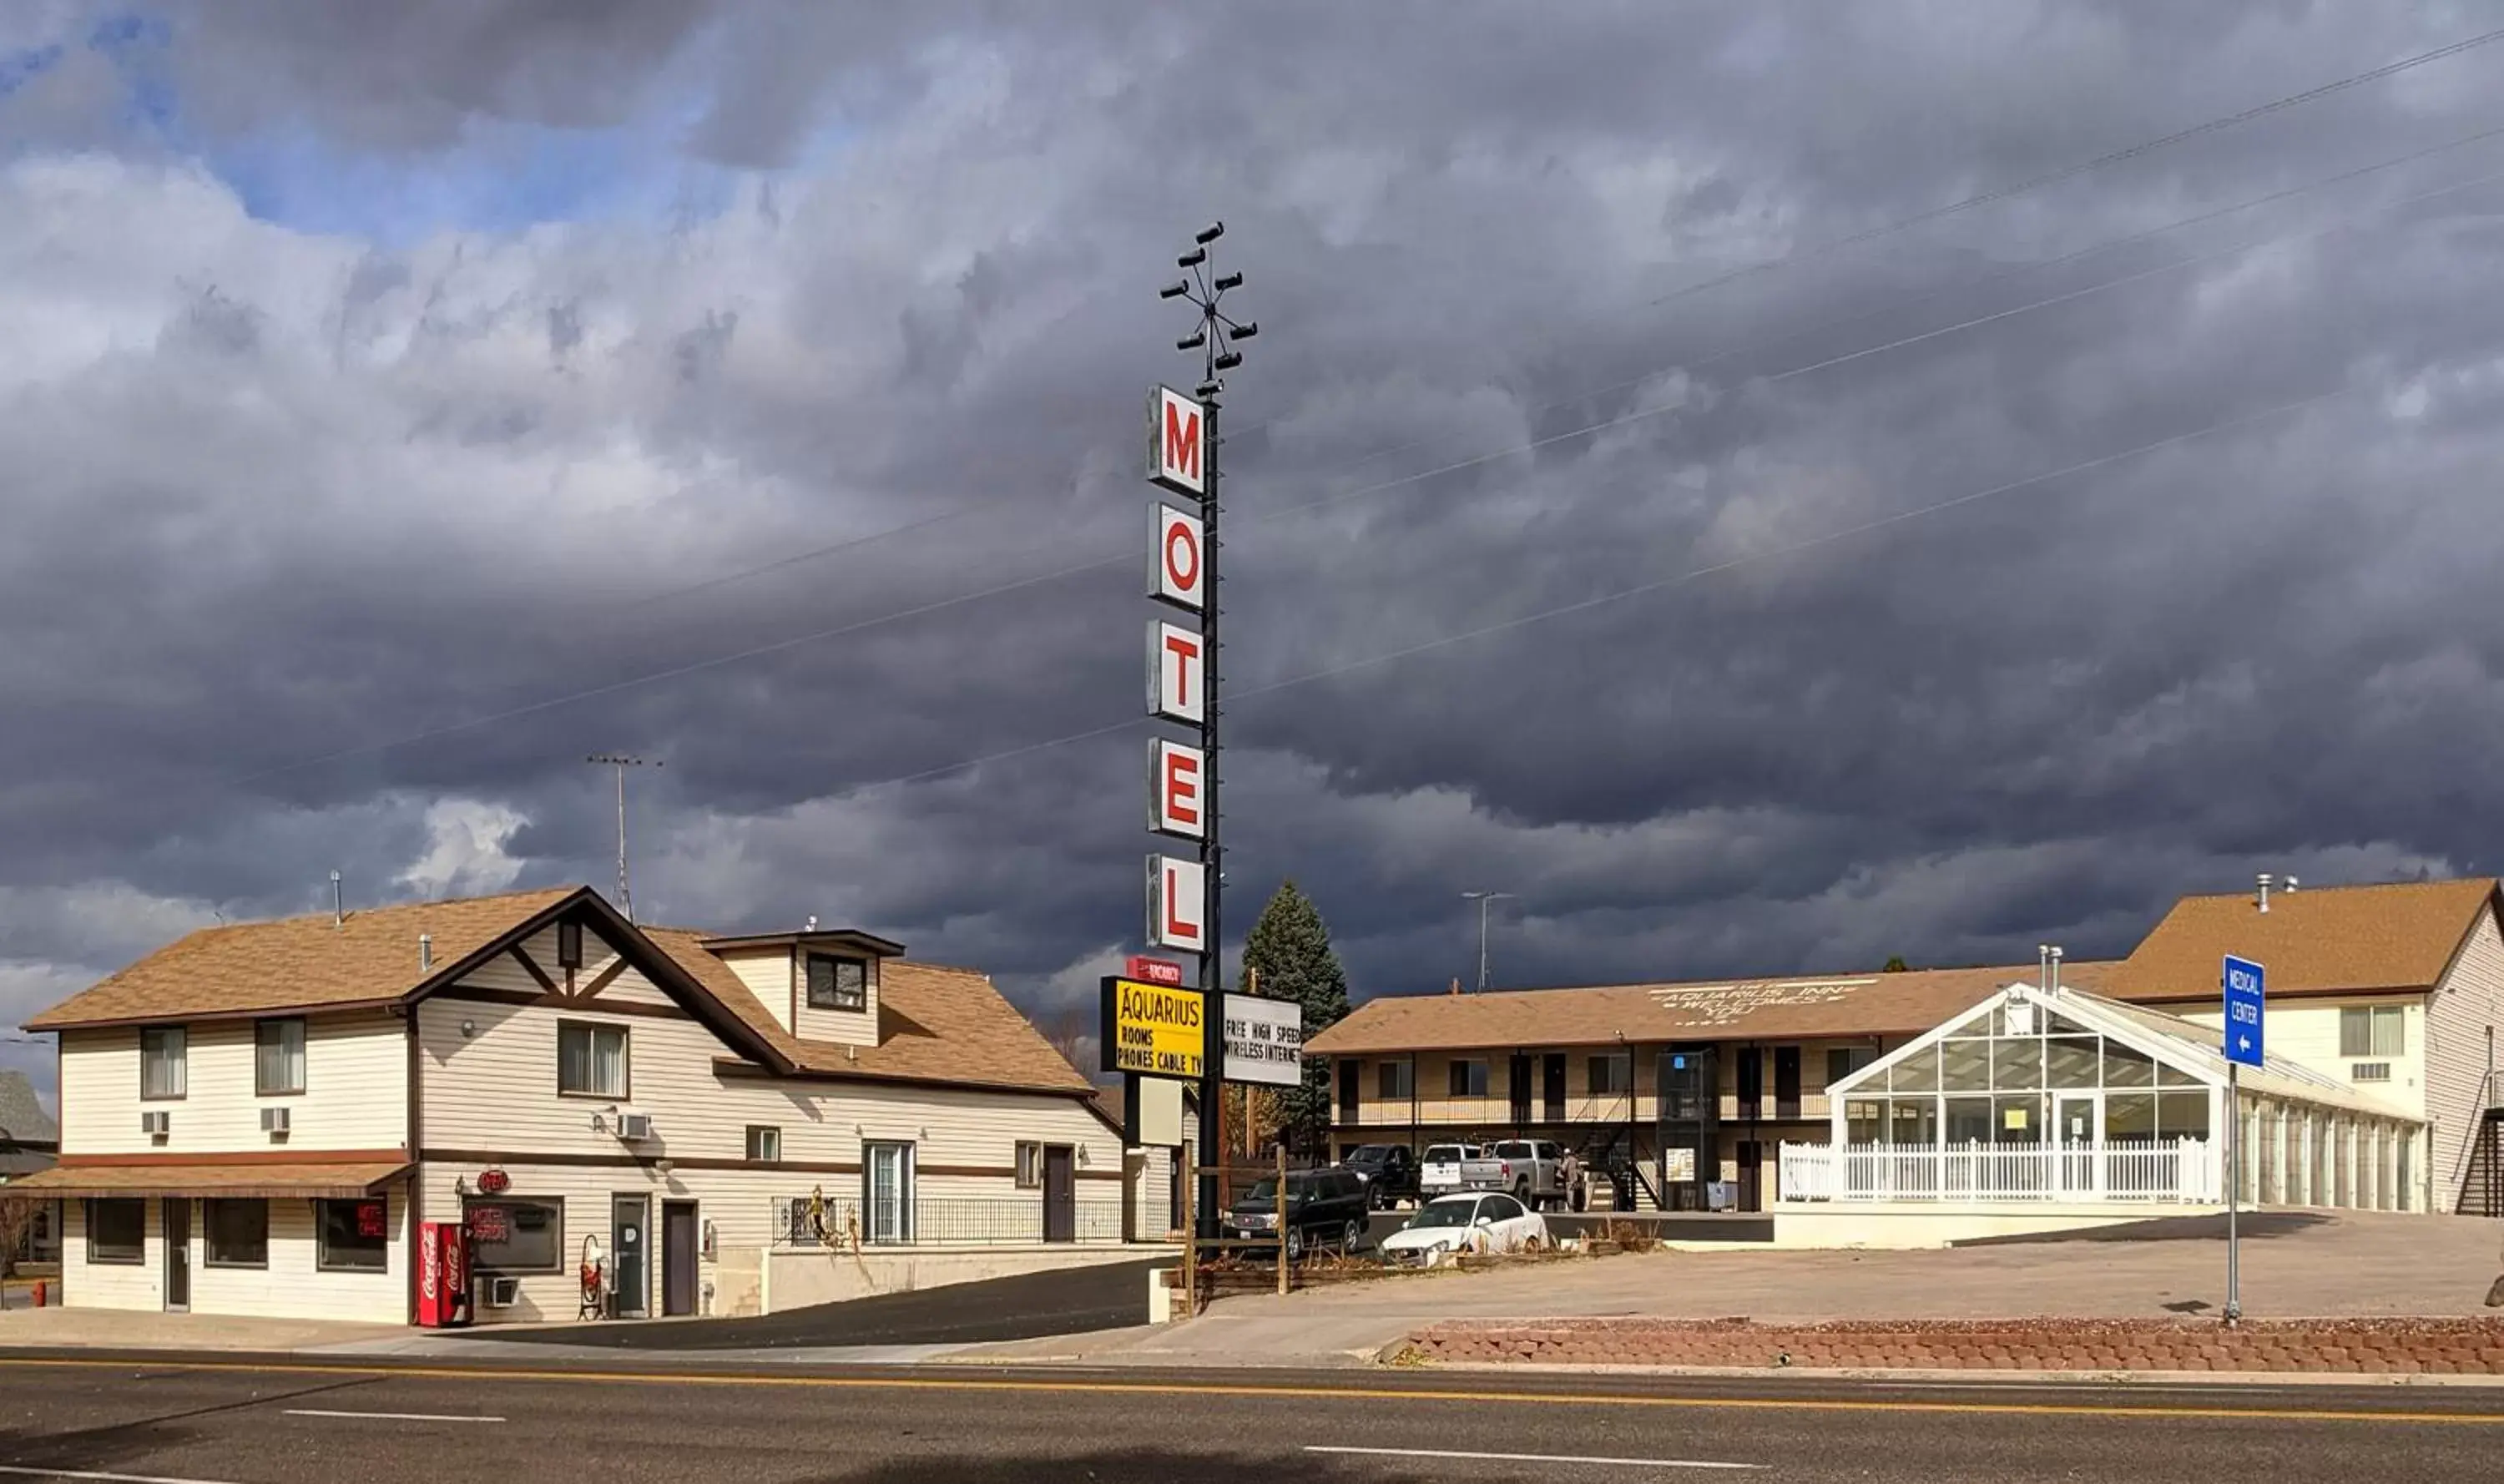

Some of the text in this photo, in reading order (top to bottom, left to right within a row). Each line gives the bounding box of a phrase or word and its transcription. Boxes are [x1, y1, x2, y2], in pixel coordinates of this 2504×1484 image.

[1166, 400, 1199, 939] MOTEL
[2229, 968, 2260, 996] MEDICAL
[1120, 986, 1200, 1027] AQUARIUS
[2231, 1000, 2258, 1026] CENTER
[1121, 1025, 1154, 1046] ROOMS
[1226, 1019, 1302, 1044] FREE HIGH SPEED
[1118, 1047, 1202, 1074] PHONES CABLE TV
[1224, 1040, 1302, 1063] WIRELESS INTERNET
